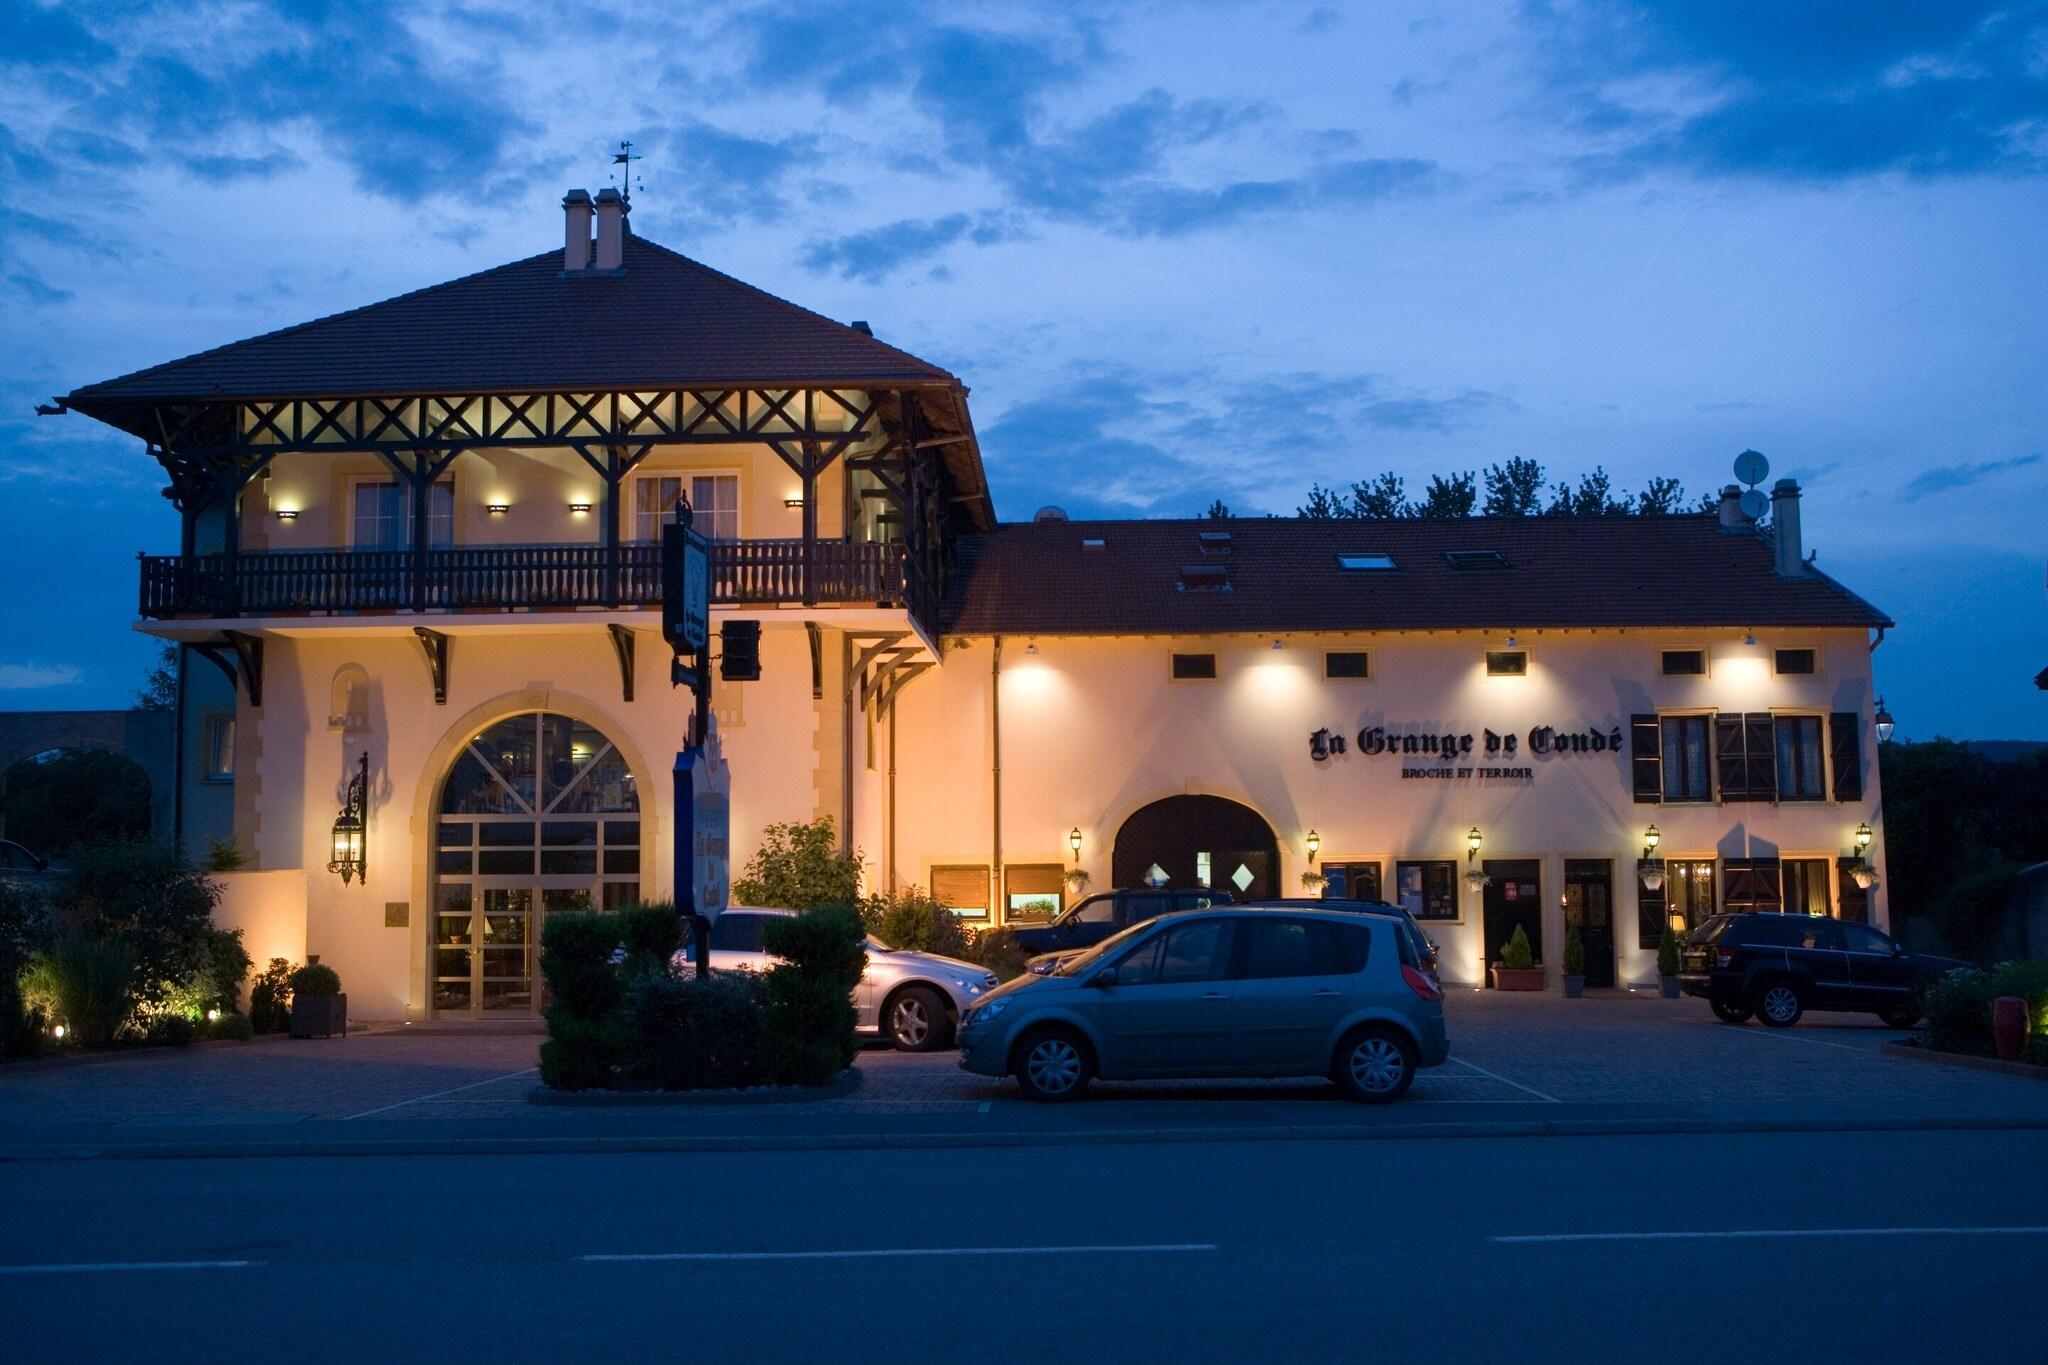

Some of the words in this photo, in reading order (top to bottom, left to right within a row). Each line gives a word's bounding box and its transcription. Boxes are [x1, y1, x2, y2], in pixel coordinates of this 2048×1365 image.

[1309, 727, 1347, 761] La
[1357, 726, 1474, 760] Grange
[1484, 727, 1518, 753] de
[1528, 725, 1624, 754] Condé
[1402, 768, 1453, 778] BROCHE
[1457, 768, 1473, 778] ET
[1478, 767, 1533, 778] TERROIR
